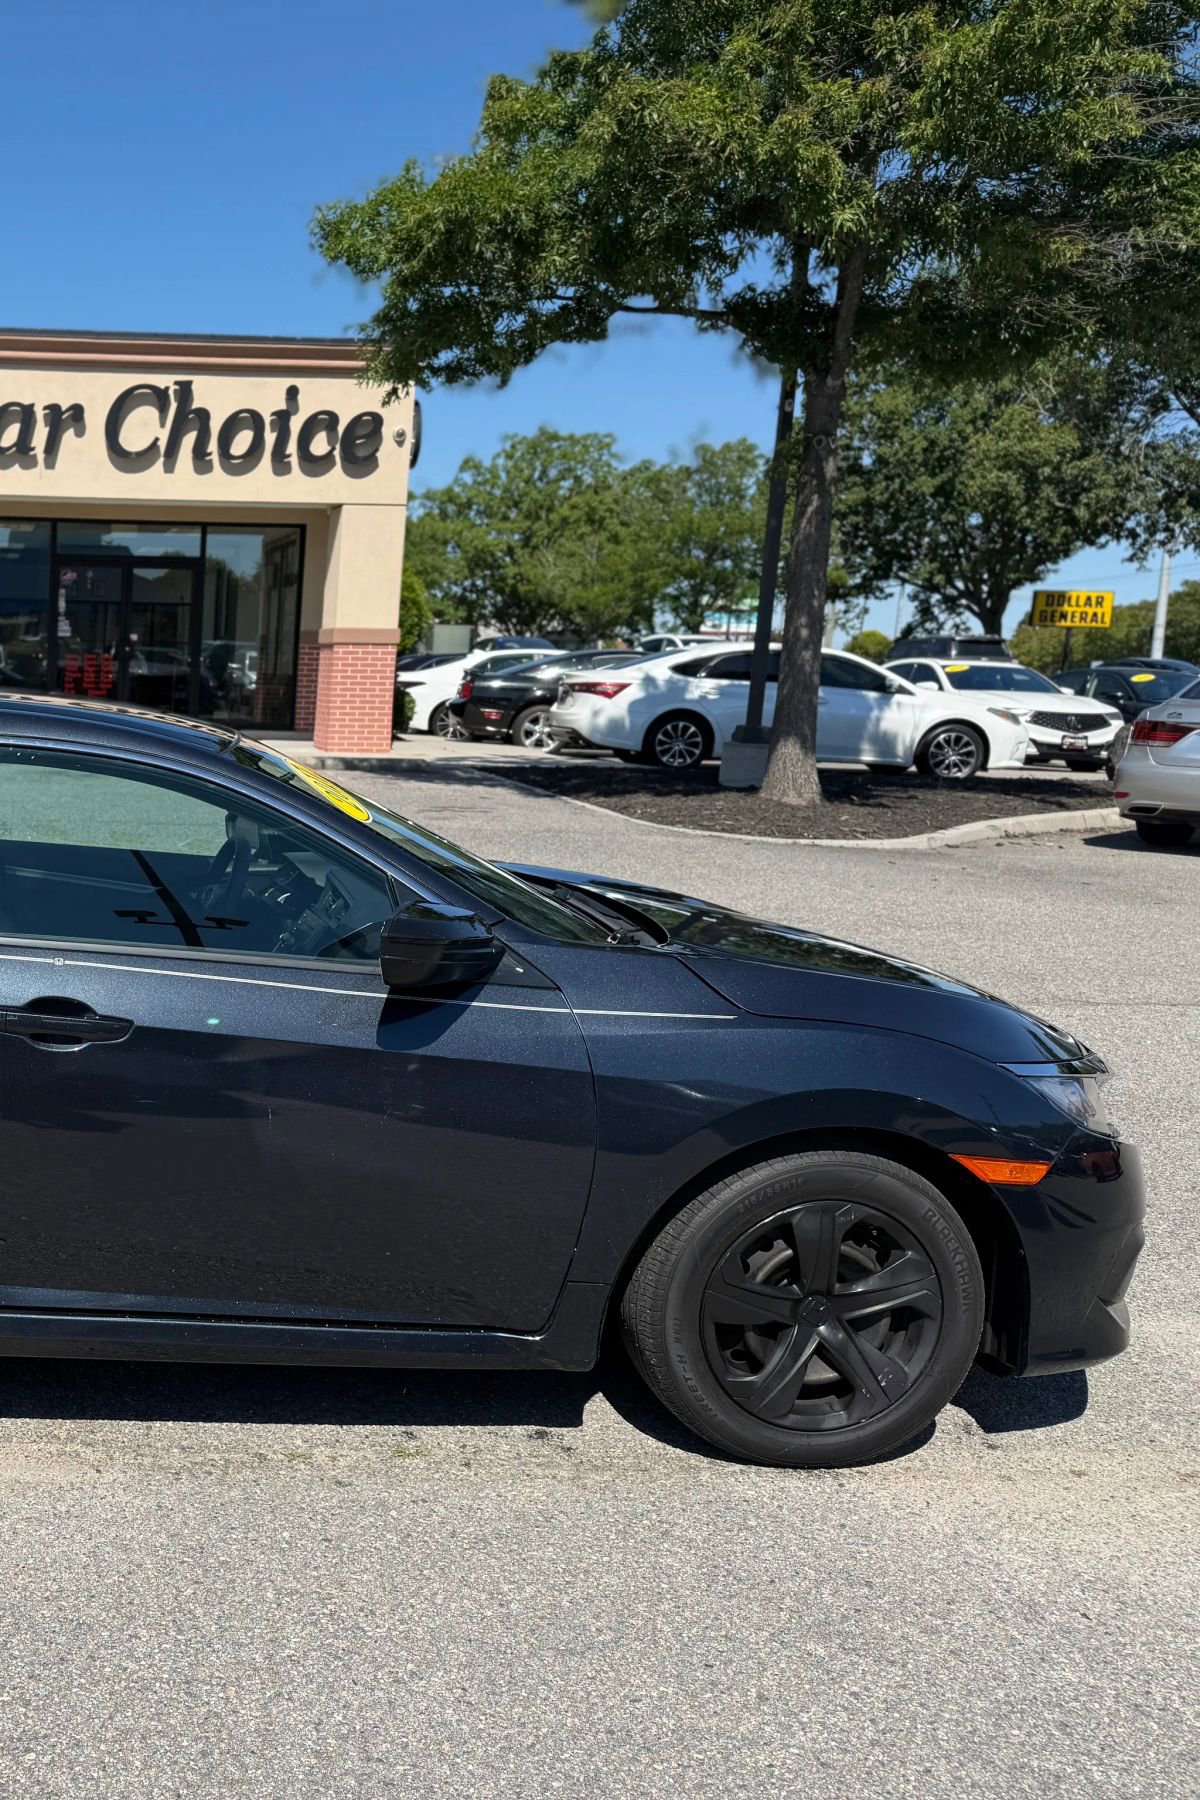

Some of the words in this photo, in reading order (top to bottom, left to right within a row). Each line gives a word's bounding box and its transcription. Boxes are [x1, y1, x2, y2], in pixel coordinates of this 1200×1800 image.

[104, 379, 384, 466] Choice
[1045, 593, 1105, 609] DOLLAR
[1038, 609, 1108, 625] GENERAL
